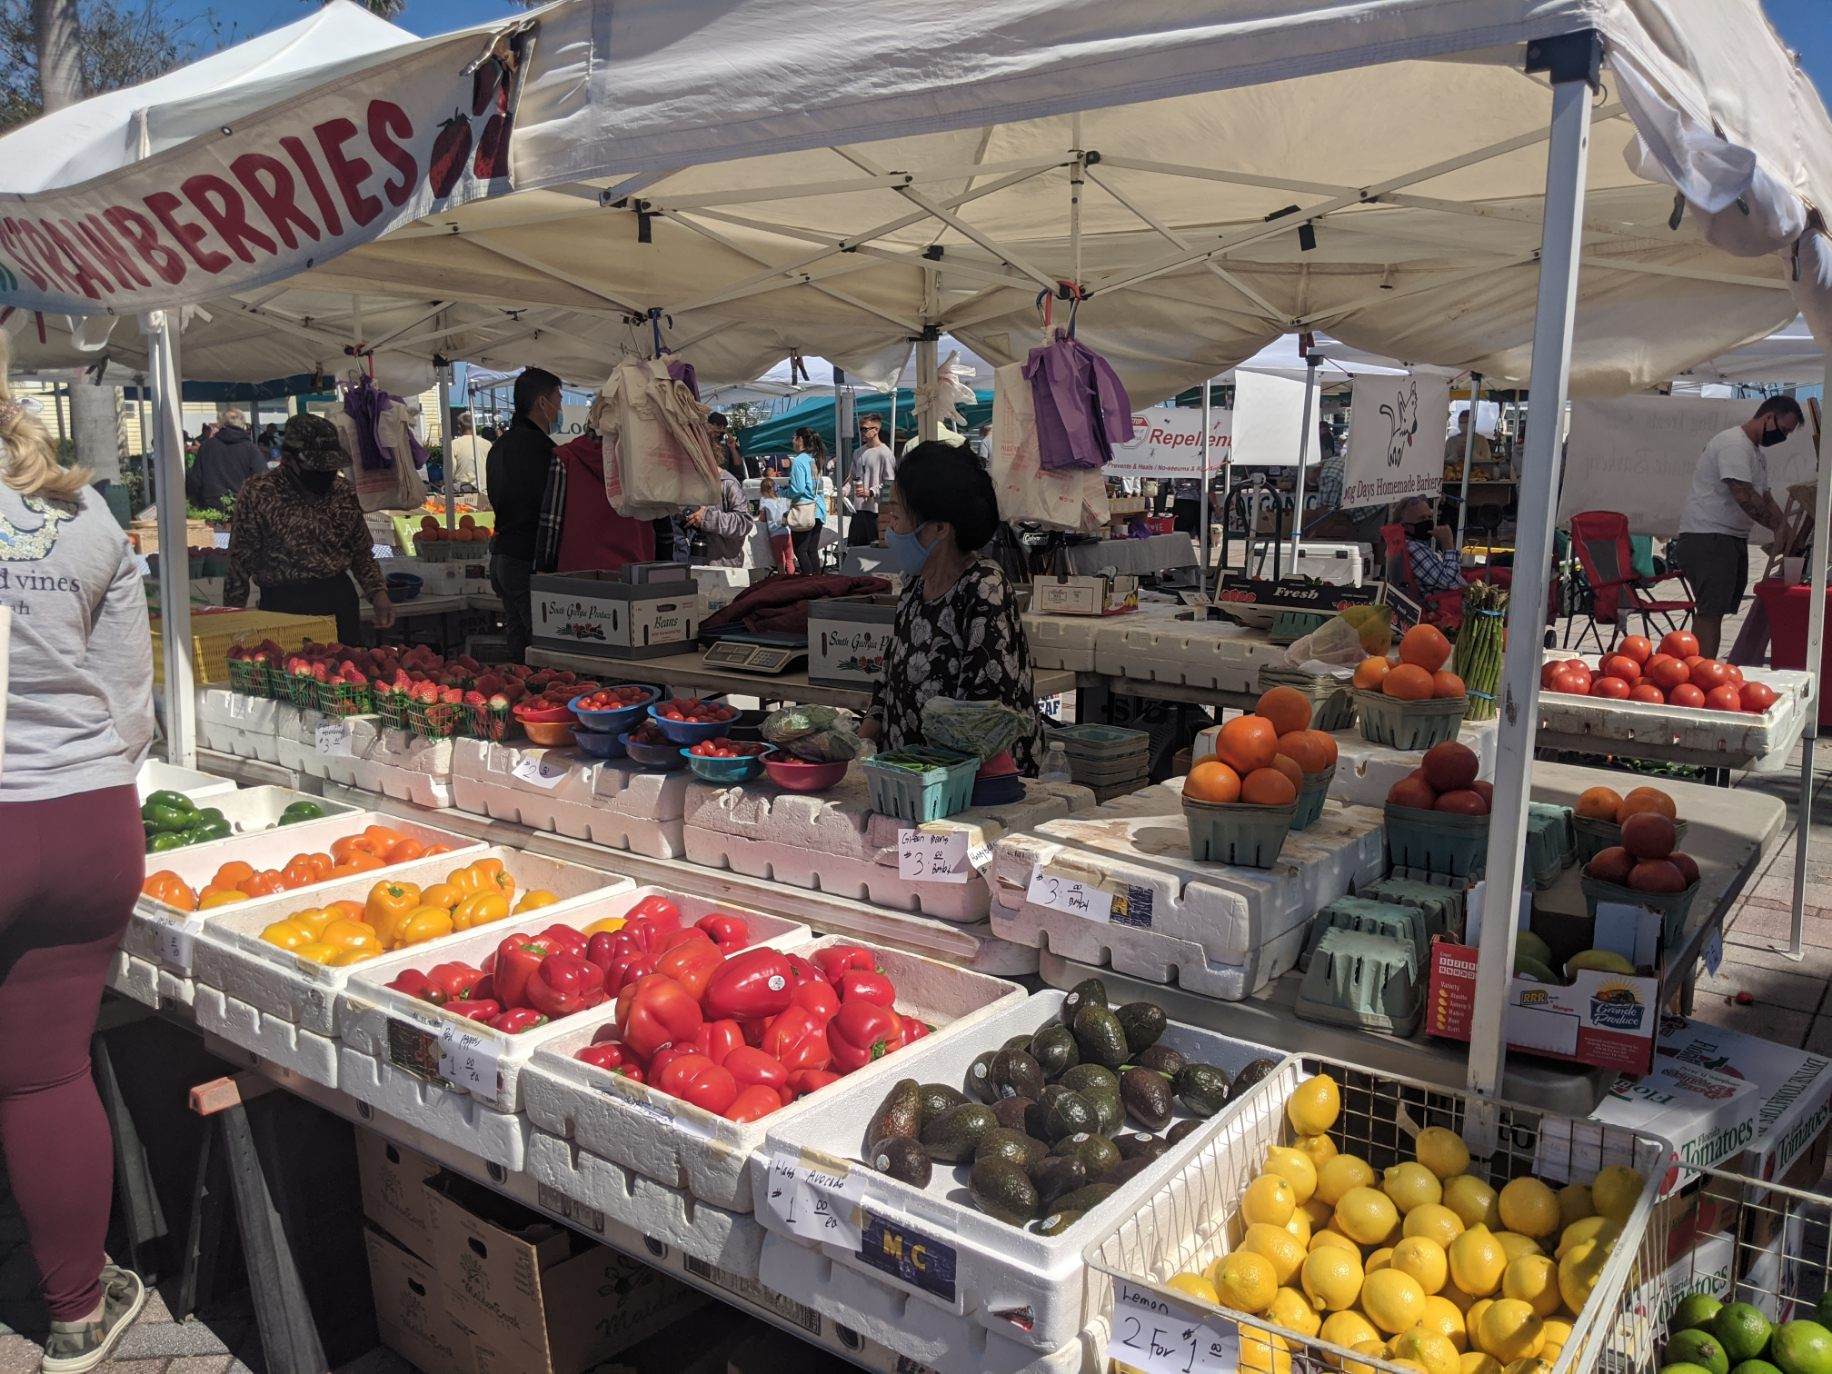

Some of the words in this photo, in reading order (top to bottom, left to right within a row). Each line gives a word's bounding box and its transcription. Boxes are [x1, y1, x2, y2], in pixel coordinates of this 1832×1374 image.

[0, 99, 419, 301] STRAWBERRIES
[1357, 479, 1375, 502] Days
[1376, 477, 1416, 497] Homemade
[15, 570, 80, 592] vines
[1273, 587, 1319, 600] Fresh
[829, 631, 849, 647] South
[1681, 1117, 1753, 1179] Tomatoes
[806, 1171, 845, 1189] Avocado
[1123, 1285, 1169, 1315] Lemon
[1122, 1316, 1141, 1349] 2
[1149, 1328, 1175, 1360] For
